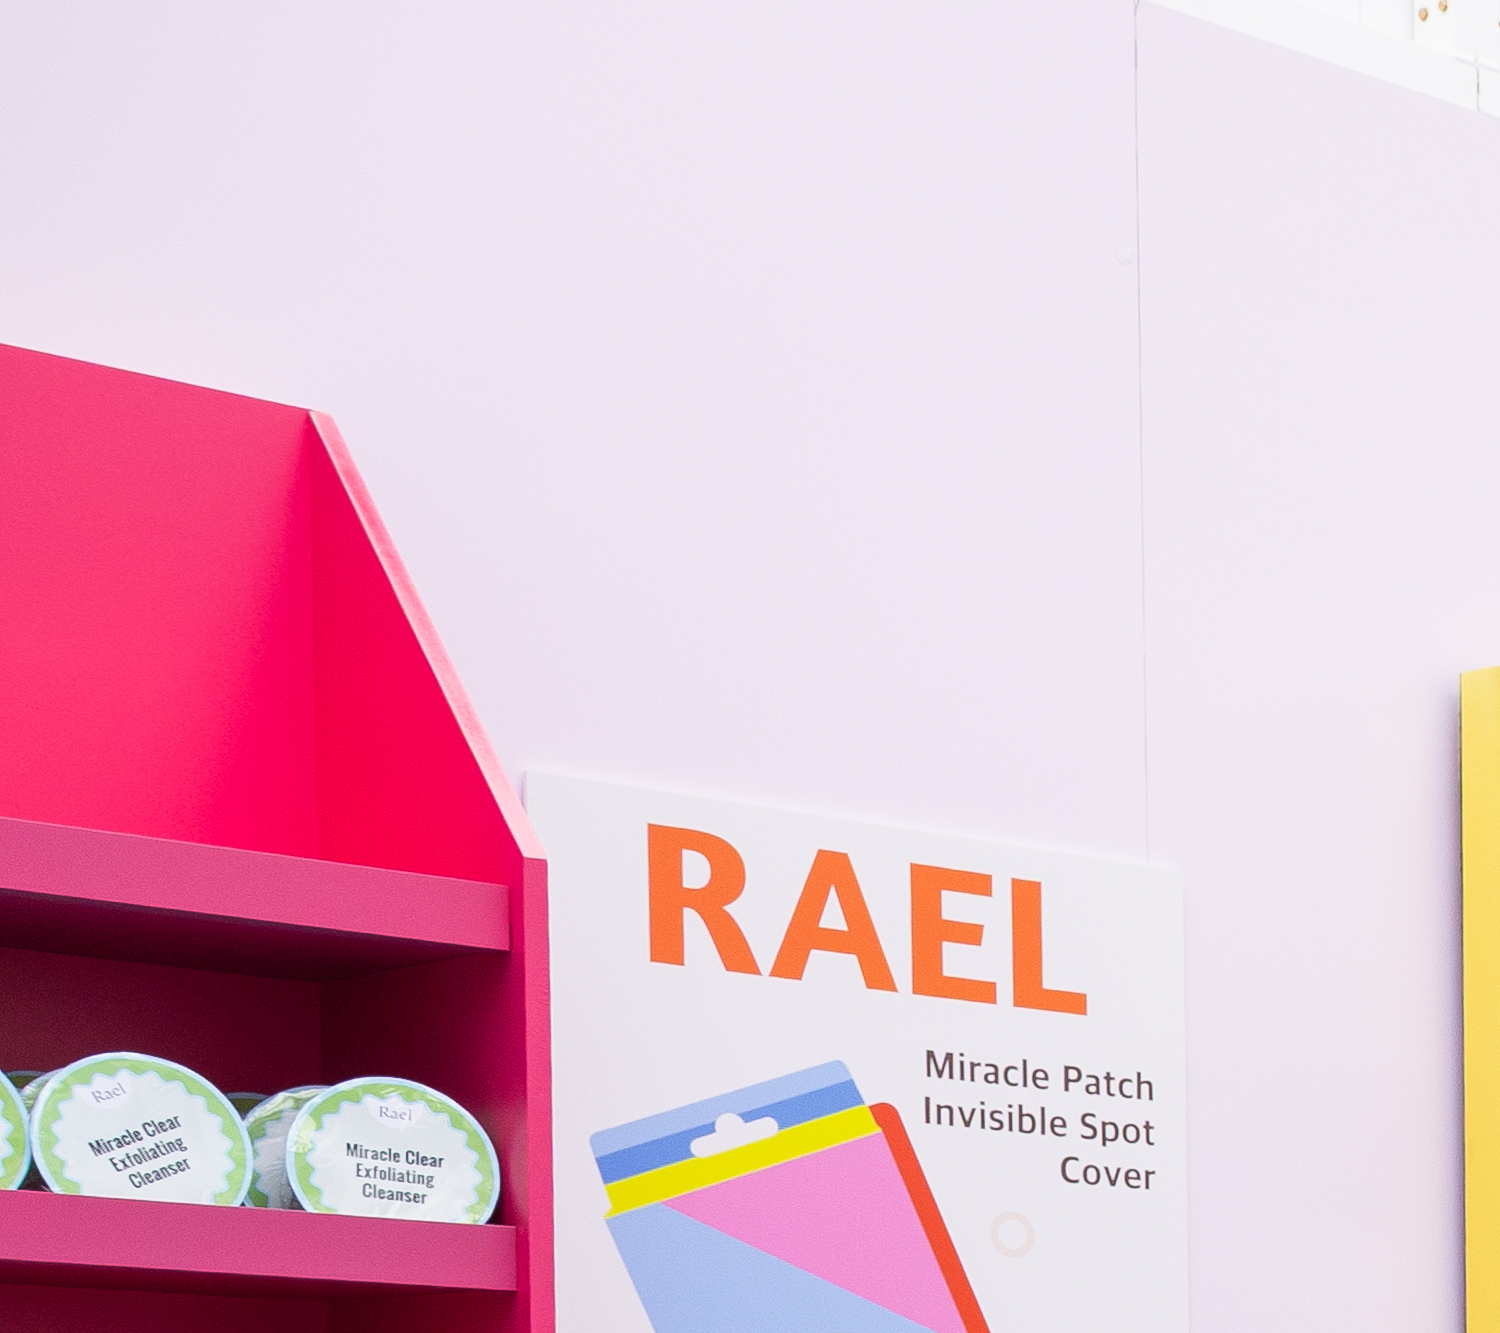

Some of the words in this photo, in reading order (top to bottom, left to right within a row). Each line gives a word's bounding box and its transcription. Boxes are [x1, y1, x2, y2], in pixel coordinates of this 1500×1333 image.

[647, 823, 1088, 1015] RAEL
[925, 1050, 1049, 1089] Miracle
[1063, 1065, 1154, 1101] Patch
[378, 1104, 413, 1122] Rael
[923, 1097, 1067, 1137] Invisible
[1080, 1112, 1155, 1147] Spot
[346, 1142, 401, 1165] Miracle
[404, 1148, 445, 1168] Clear
[355, 1163, 435, 1189] Exfoliating
[1060, 1156, 1156, 1190] Cover
[362, 1182, 428, 1205] Cleanser
